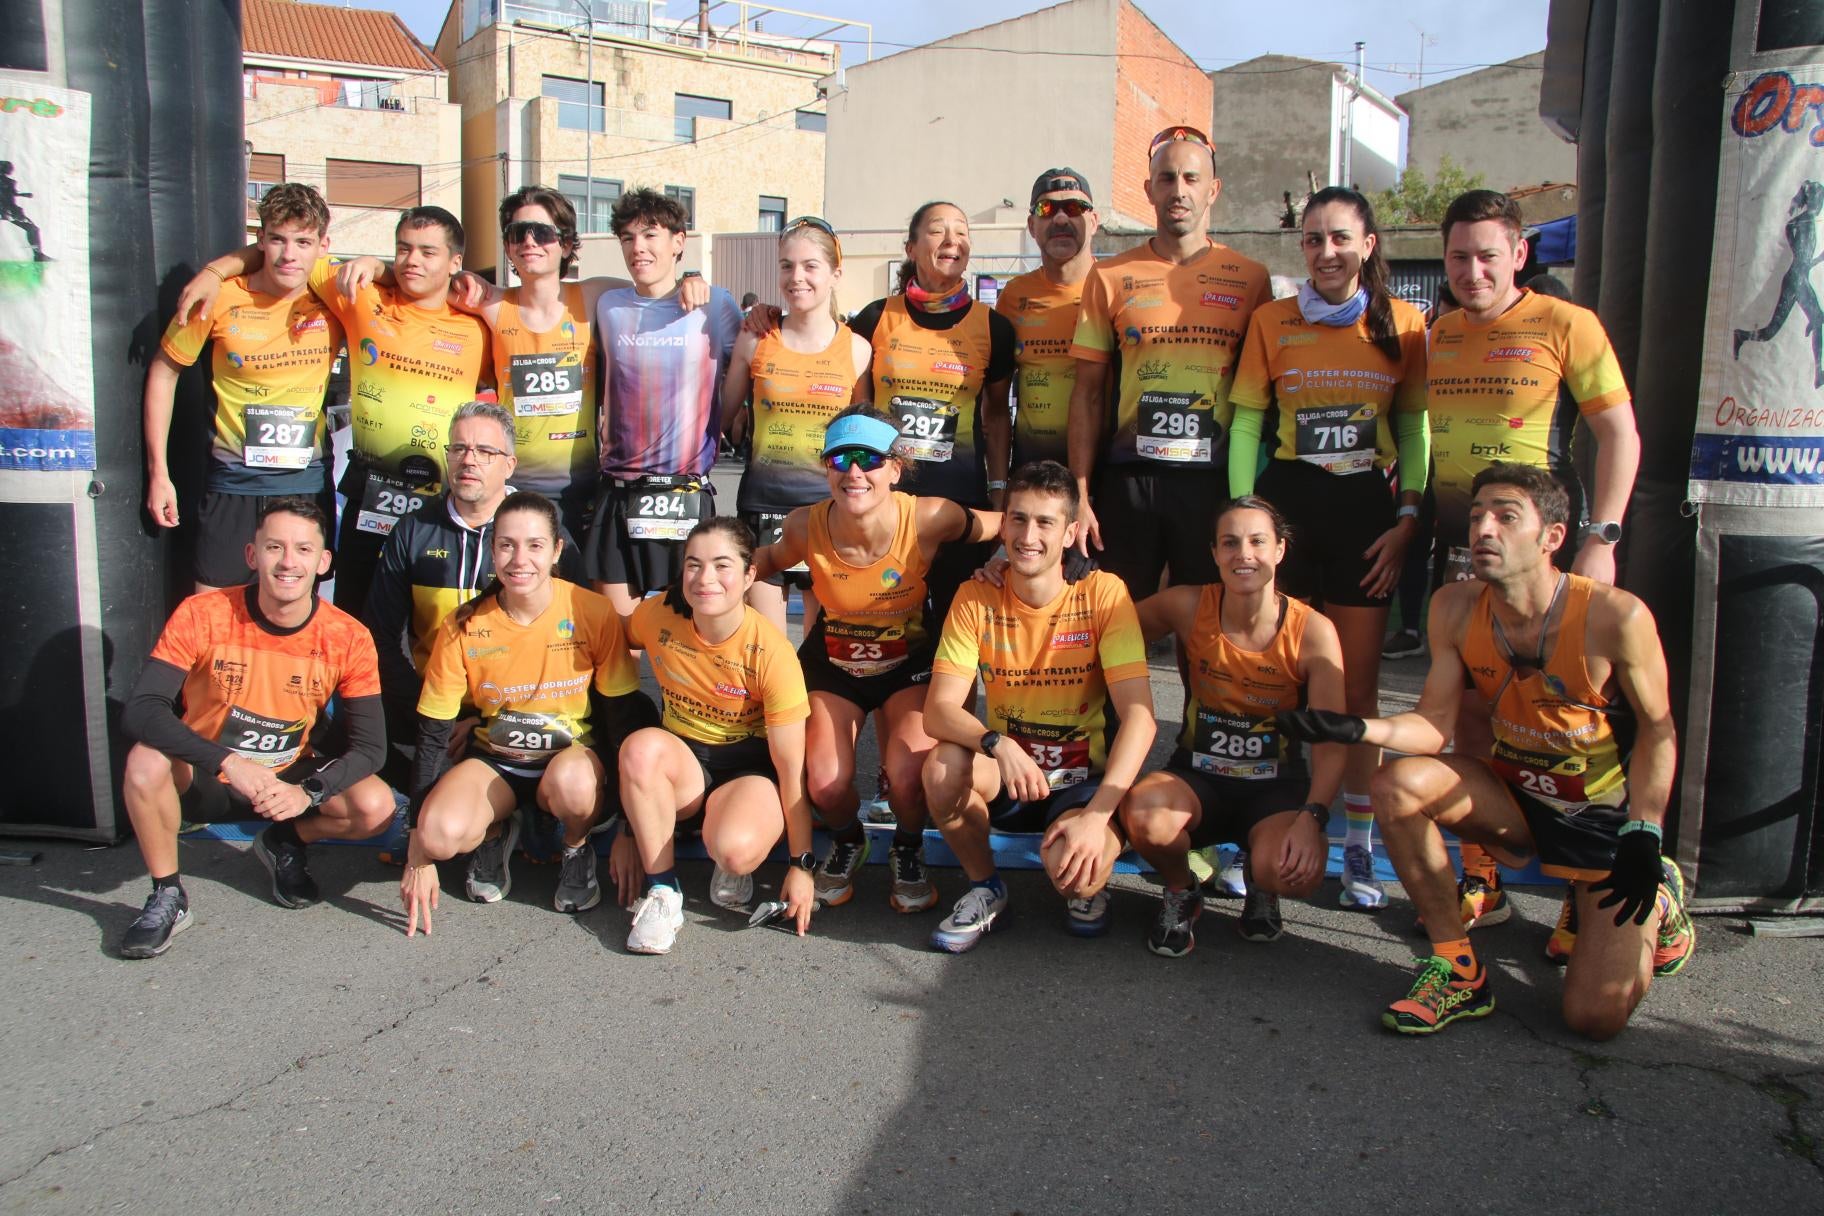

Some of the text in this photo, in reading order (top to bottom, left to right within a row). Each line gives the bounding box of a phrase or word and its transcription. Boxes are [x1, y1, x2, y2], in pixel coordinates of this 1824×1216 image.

[1141, 326, 1189, 334] ESCUELA
[1152, 337, 1227, 347] SALMANTINA
[244, 351, 288, 362] ESCUELA
[536, 357, 557, 365] CROSS
[255, 358, 321, 370] SALMANTINA
[380, 350, 464, 376] ESCUELA TRIATLÓN
[389, 363, 454, 382] SALMANTINA
[1306, 370, 1340, 378] ESTER
[525, 370, 570, 394] 285
[892, 378, 927, 386] ESCUELA
[1306, 380, 1353, 388] CLINICA
[1430, 377, 1539, 387] ESCUELA TRIATLÓN
[900, 385, 955, 395] SALMANTINA
[1436, 387, 1514, 396] SALMANTINA
[771, 400, 805, 408] ESCUELA
[917, 402, 936, 410] CROSS
[1168, 397, 1190, 405] CROSS
[254, 408, 270, 416] LIGA
[1305, 412, 1321, 420] LIGA
[1326, 410, 1348, 418] CROSS
[902, 413, 945, 439] 297
[1151, 411, 1200, 436] 296
[260, 423, 306, 445] 287
[1314, 425, 1358, 450] 716
[767, 444, 794, 452] ALTAFIT
[1140, 444, 1208, 458] JOMISAGA
[376, 475, 391, 484] LIA
[376, 491, 423, 515] 298
[639, 495, 685, 517] 284
[834, 627, 849, 635] LIGA
[849, 642, 883, 659] 23
[503, 674, 589, 694] ESTER ODRIGUEZ
[705, 705, 760, 718] TRIATLÓN
[231, 709, 285, 730] 33 LIGA CROSS
[503, 715, 517, 724] LIGA
[521, 718, 544, 726] CROSS
[1227, 719, 1251, 728] CROSS
[1037, 729, 1060, 738] CROSS
[239, 730, 290, 751] 281
[508, 730, 553, 750] 291
[1210, 731, 1263, 758] 289
[1030, 743, 1063, 767] 33
[1524, 755, 1549, 767] CROSS
[1519, 770, 1558, 796] 26
[1446, 987, 1473, 1009] asics
